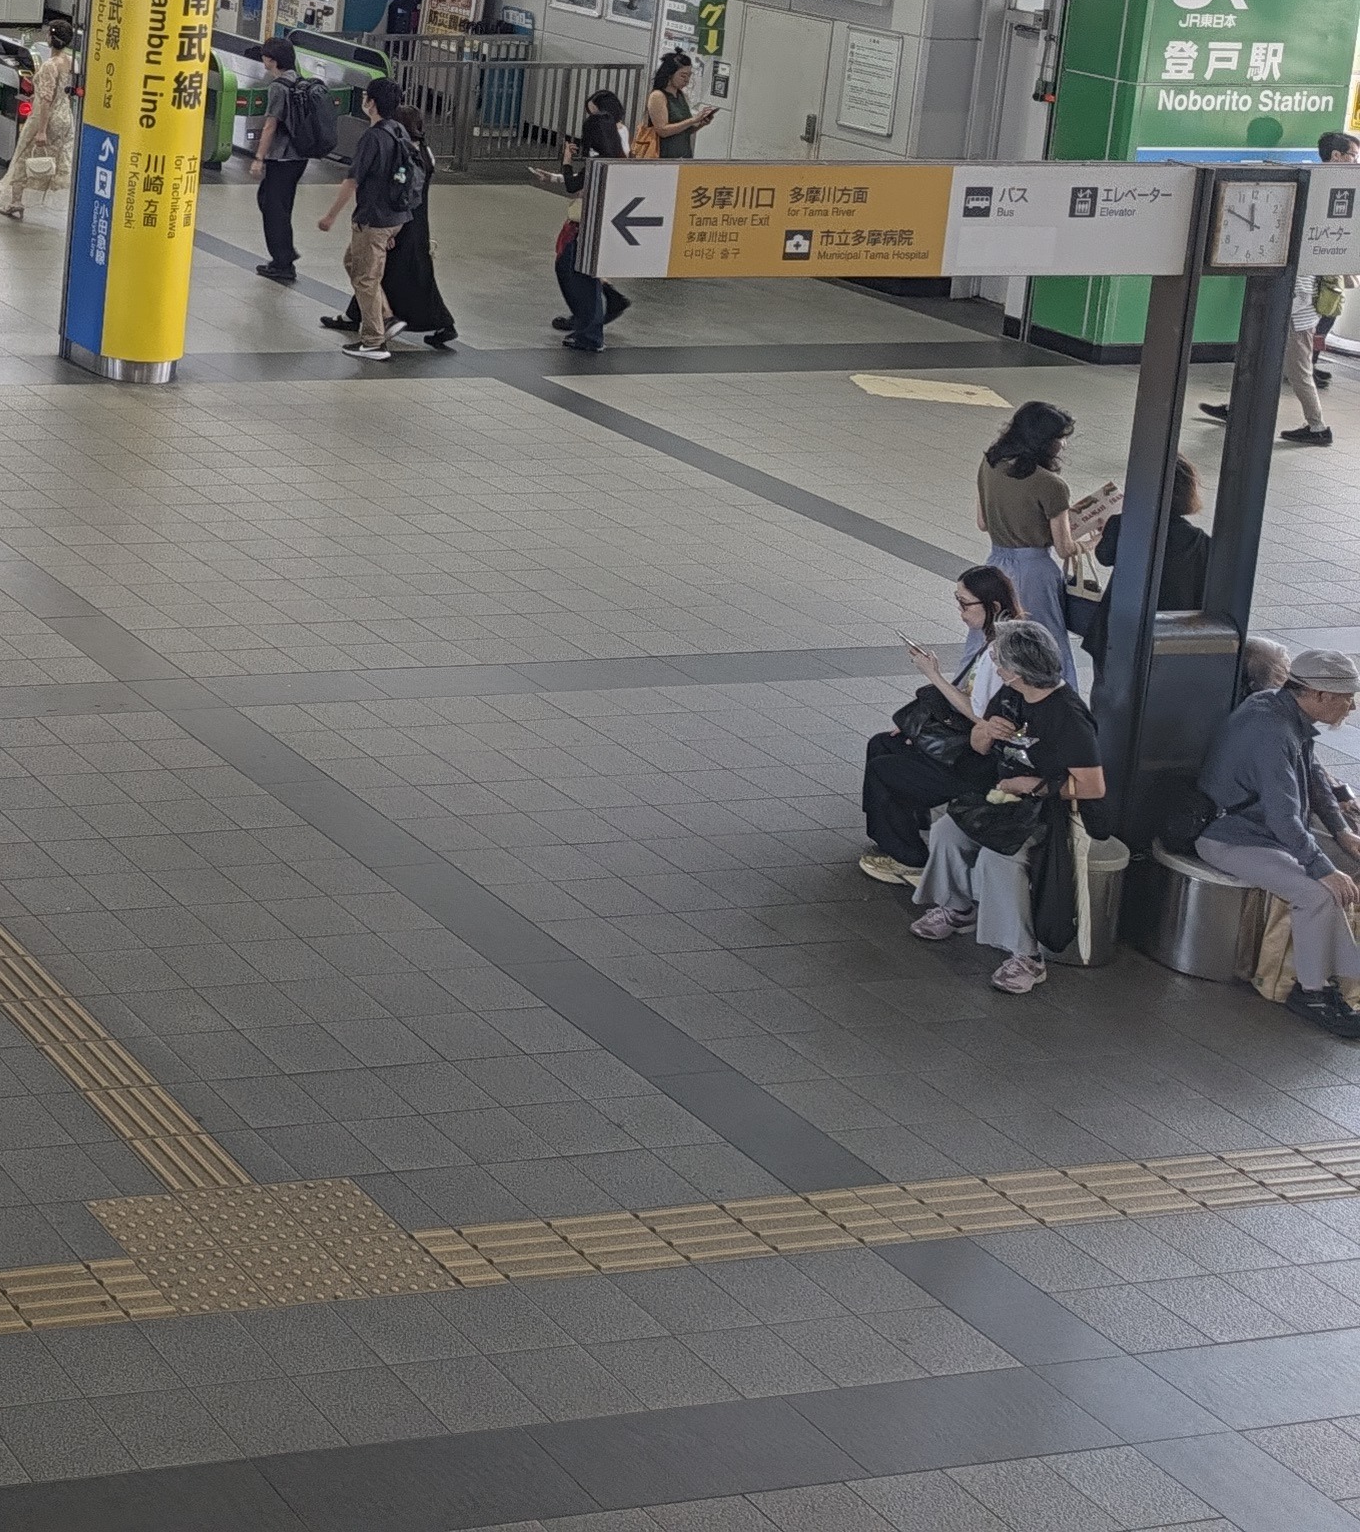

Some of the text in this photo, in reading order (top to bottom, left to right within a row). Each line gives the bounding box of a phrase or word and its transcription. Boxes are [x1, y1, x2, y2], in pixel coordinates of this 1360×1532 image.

[1179, 13, 1237, 28] JR東日本
[94, 28, 104, 61] Line
[1161, 41, 1285, 81] 登戸駅
[103, 62, 115, 109] のりば
[139, 74, 165, 129] Line
[1158, 89, 1334, 113] Noborito Station
[124, 151, 142, 229] for Kawasaki
[142, 154, 166, 228] 川崎 方面
[167, 155, 185, 239] for Tachikawa
[183, 155, 198, 227] 立川 方面
[691, 186, 775, 209] 多摩川口
[789, 186, 869, 204] 多摩川方面
[998, 187, 1029, 203] バス
[1101, 187, 1172, 203] エレベーター
[689, 214, 770, 226] Tama River Exit
[787, 208, 856, 217] for Tama River
[997, 208, 1014, 218] Bus
[1100, 207, 1137, 218] Elevator
[95, 204, 110, 266] 小田急線
[686, 231, 739, 243] 多摩川出口
[820, 229, 914, 246] 市立多摩病院
[1308, 226, 1351, 241] エレベーター
[684, 248, 715, 259] 다마강
[817, 250, 929, 261] Municipal Tama Hospital
[1313, 246, 1347, 255] Elevator
